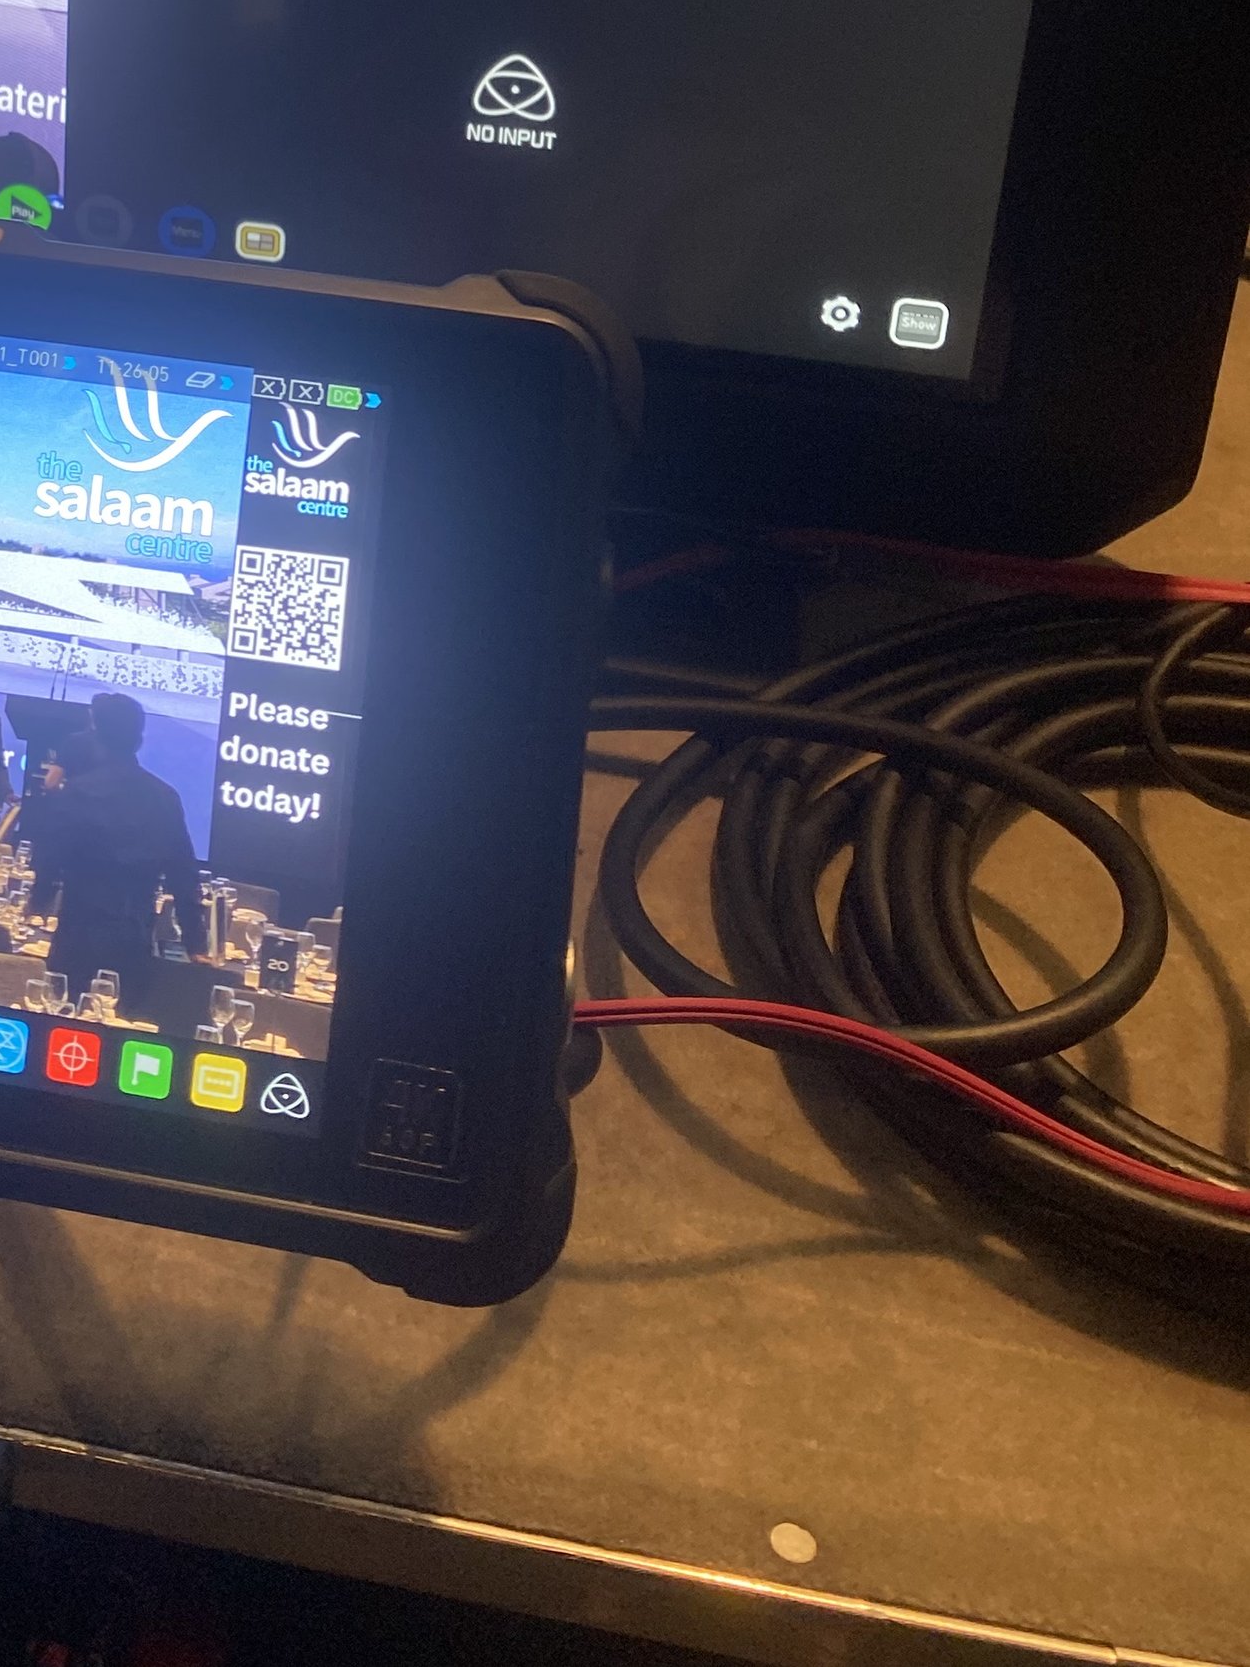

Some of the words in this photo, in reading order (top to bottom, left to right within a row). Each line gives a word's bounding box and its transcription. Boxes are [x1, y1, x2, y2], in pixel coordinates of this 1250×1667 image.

[465, 123, 495, 144] NO
[497, 127, 557, 150] INPUT
[11, 204, 36, 221] Play
[901, 316, 937, 331] Show
[37, 451, 83, 482] the
[246, 455, 273, 475] the
[244, 466, 350, 504] salaam
[33, 475, 214, 537] salaam
[296, 497, 349, 518] centre
[125, 533, 214, 563] centre
[228, 693, 330, 731] Please
[220, 735, 331, 775] donate
[220, 781, 323, 824] today!
[267, 958, 290, 972] 20
